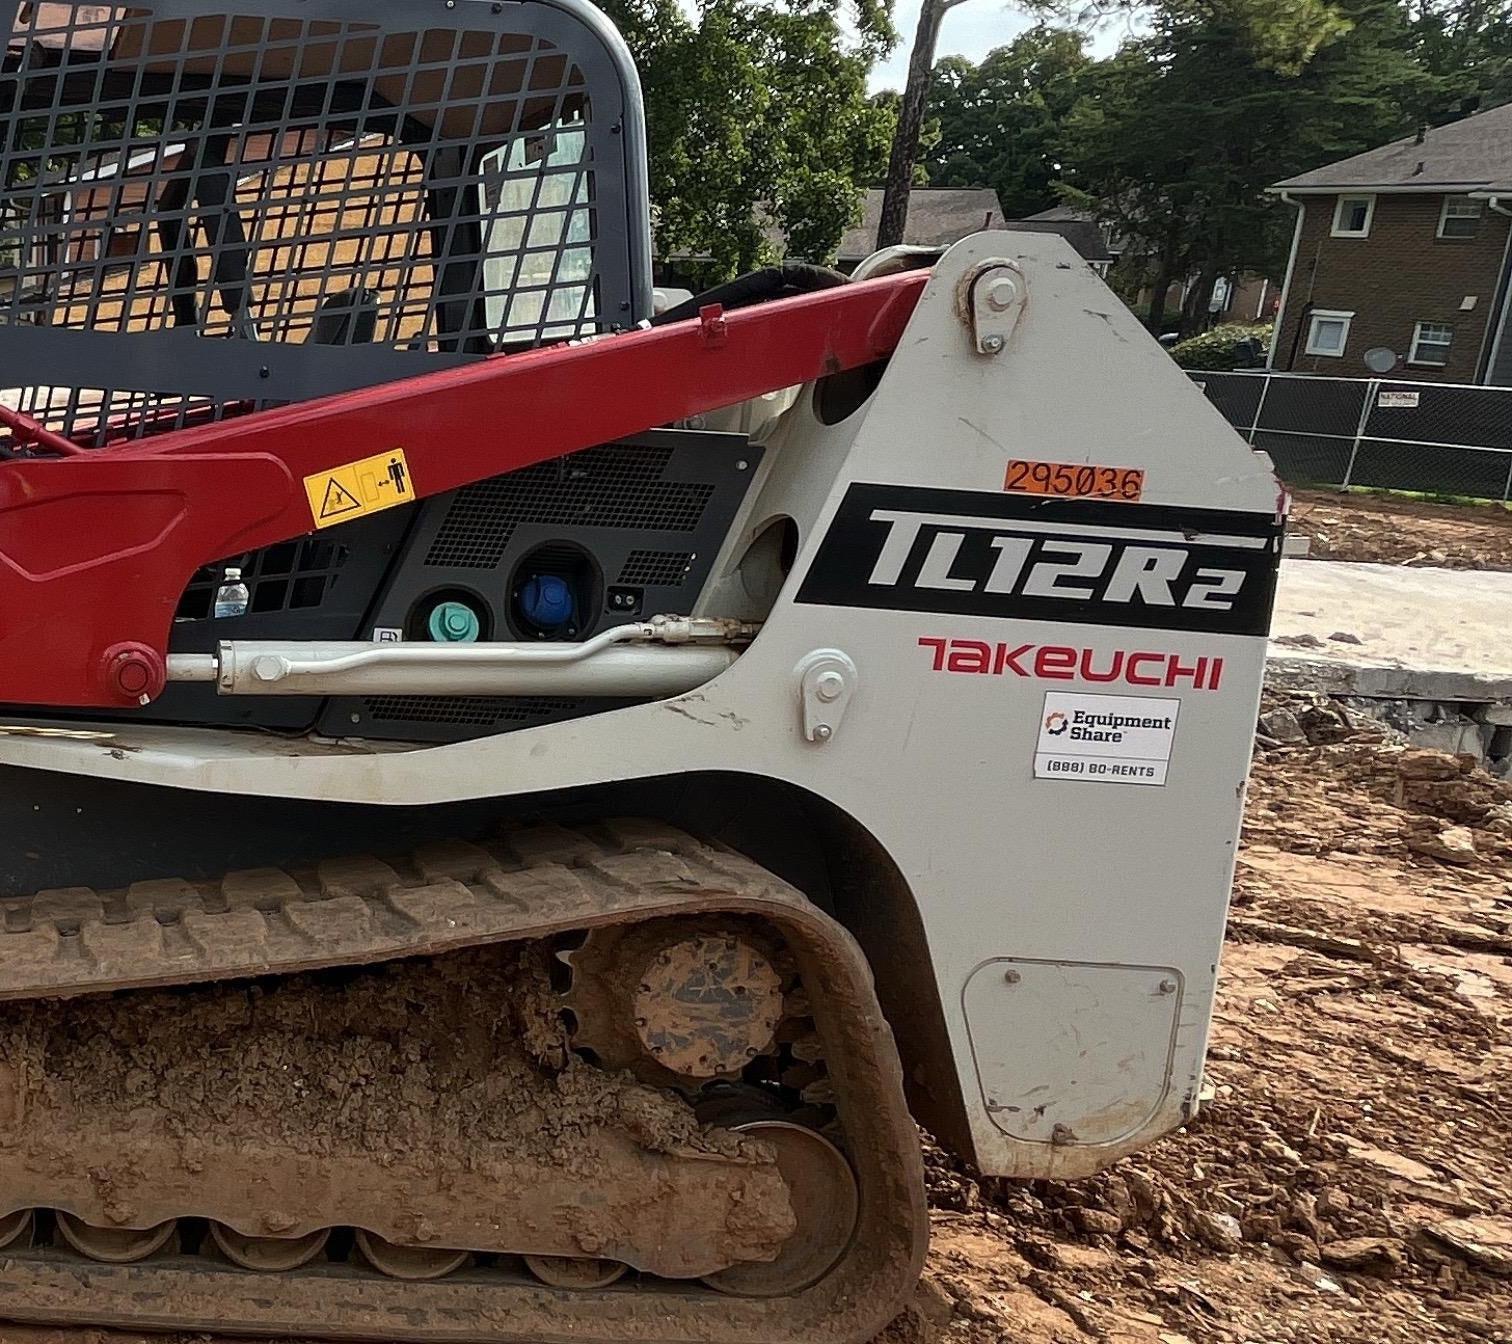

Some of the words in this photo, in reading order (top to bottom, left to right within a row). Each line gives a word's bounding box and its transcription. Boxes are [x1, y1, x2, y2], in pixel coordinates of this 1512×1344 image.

[1008, 460, 1143, 500] 295036
[867, 509, 1267, 611] TL12R2
[1072, 710, 1172, 730] Equipment
[1070, 726, 1123, 743] Share
[1047, 759, 1085, 773] (888)
[1088, 763, 1155, 777] 80-RENTS
